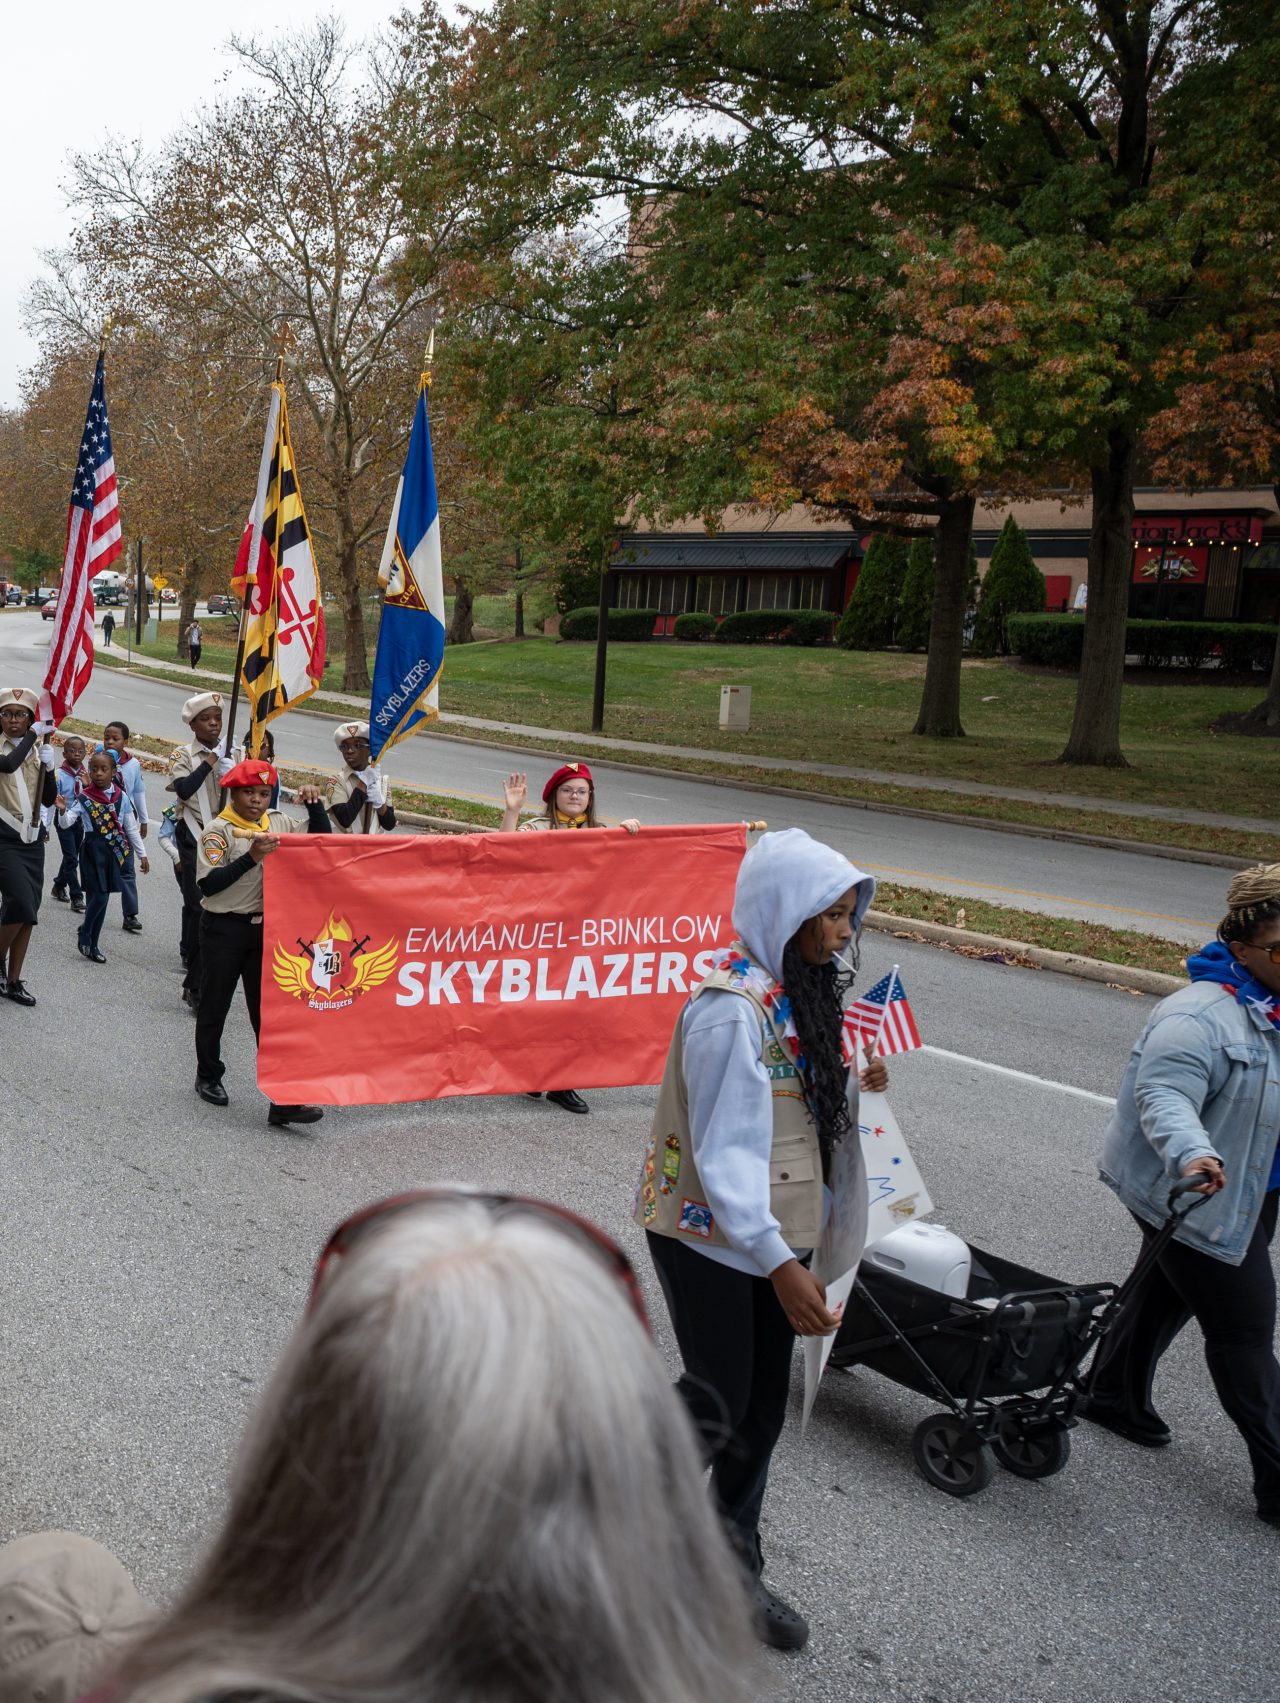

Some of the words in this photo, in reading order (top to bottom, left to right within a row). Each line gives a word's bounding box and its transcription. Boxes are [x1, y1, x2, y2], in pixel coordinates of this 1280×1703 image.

[399, 585, 416, 604] CLUB
[375, 659, 431, 726] SKYBLAZERS
[405, 914, 722, 953] EMMANUEL-BRINKLOW
[395, 950, 719, 1007] SKYBLAZERS
[309, 998, 353, 1011] Skyblazers
